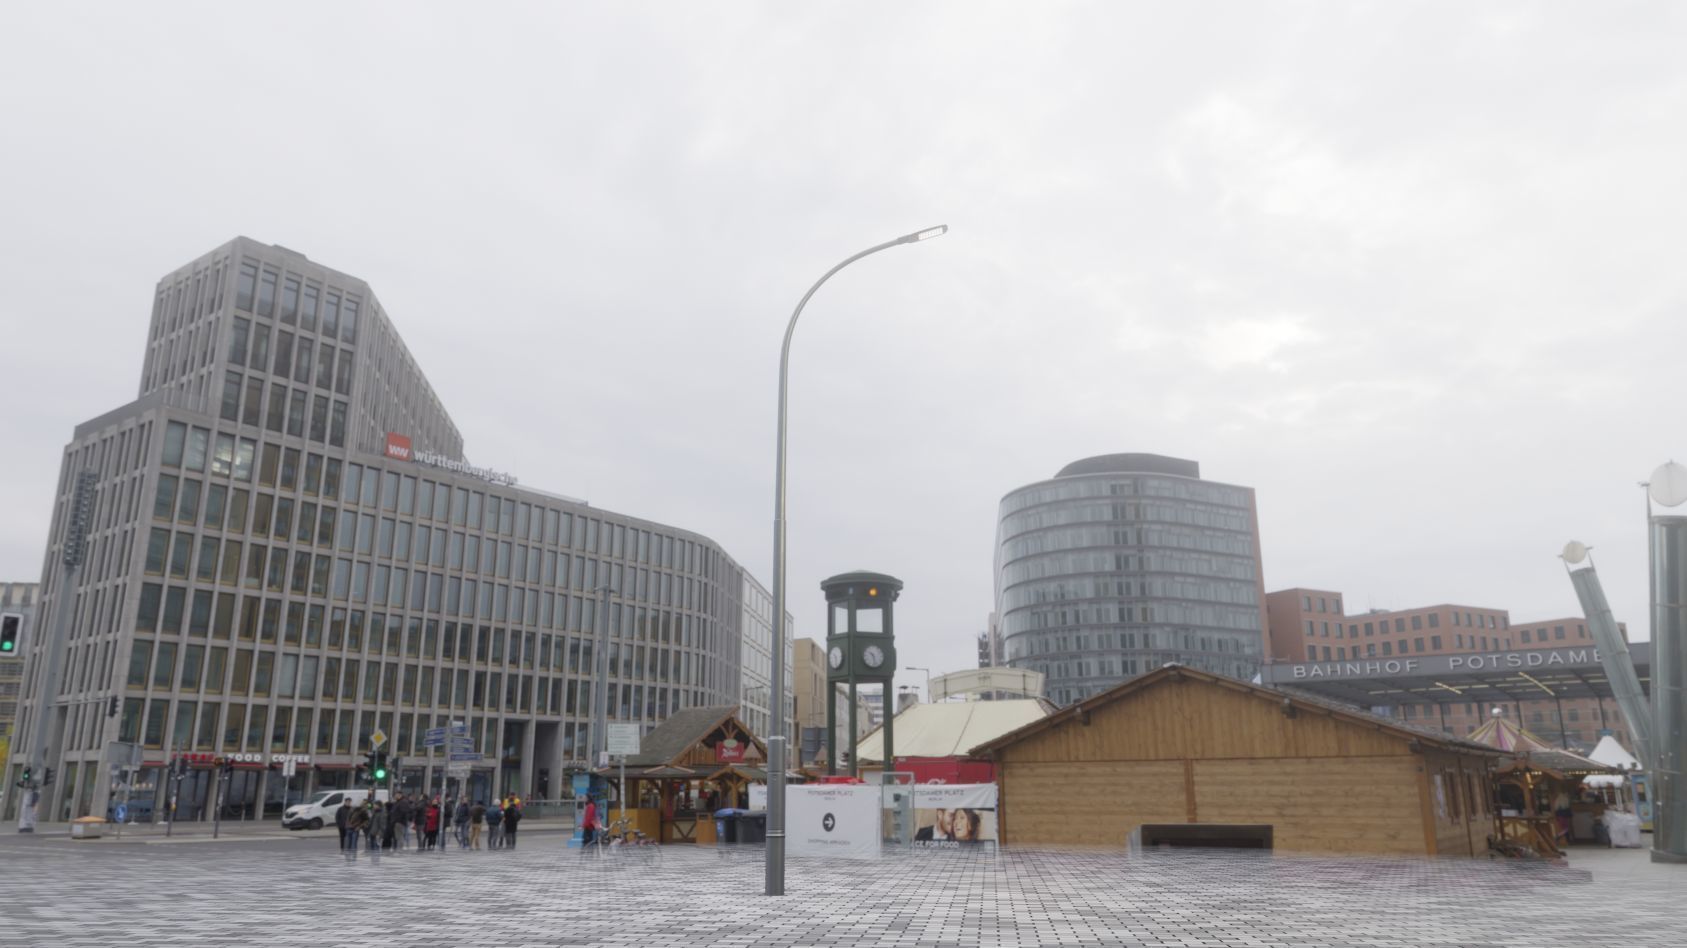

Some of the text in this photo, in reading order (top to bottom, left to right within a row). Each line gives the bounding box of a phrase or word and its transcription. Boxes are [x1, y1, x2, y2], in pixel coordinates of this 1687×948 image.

[414, 448, 518, 486] württembergische
[1293, 649, 1603, 678] BAHNHOF POTSDAME
[272, 754, 310, 762] COFFEE
[940, 841, 960, 849] FOOD
